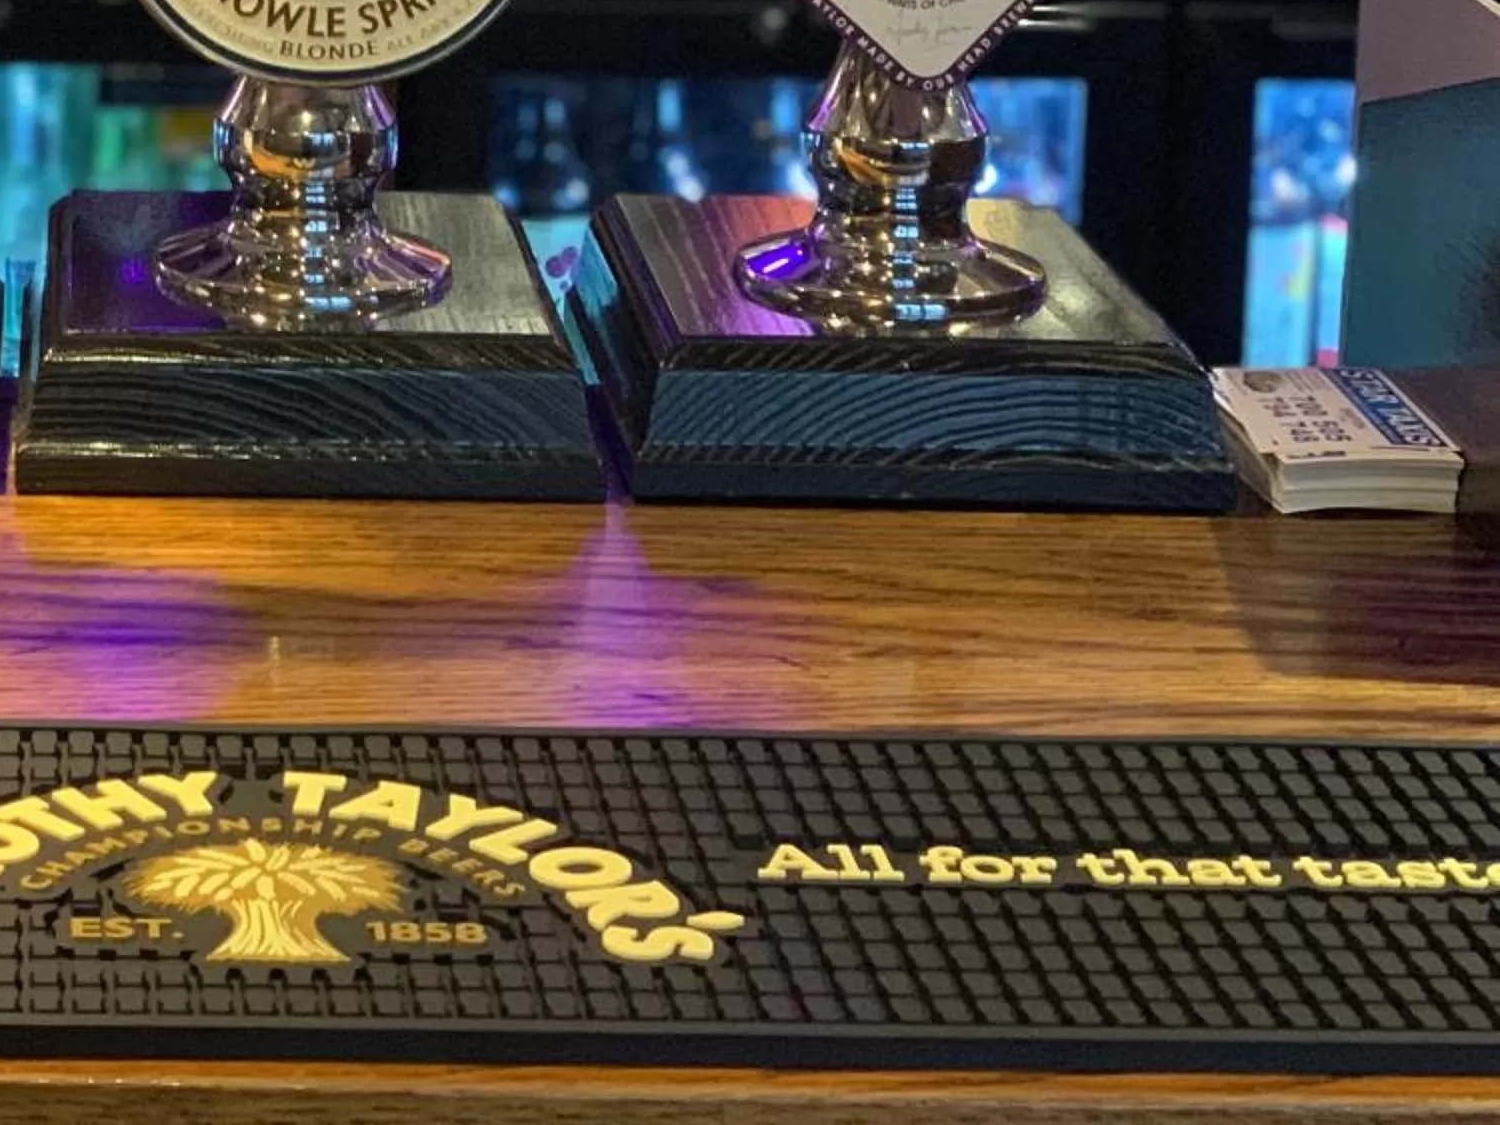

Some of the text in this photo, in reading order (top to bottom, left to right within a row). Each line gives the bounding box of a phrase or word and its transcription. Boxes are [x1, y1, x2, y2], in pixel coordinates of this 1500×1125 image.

[279, 39, 378, 61] BLONDE
[857, 35, 895, 71] MADE
[896, 71, 915, 88] BY
[923, 73, 954, 92] OUR
[957, 37, 992, 72] HEAD
[19, 816, 527, 899] CHAMPIONSHIP BEERS
[283, 771, 744, 960] TAYLOR'S
[757, 843, 904, 882] All
[919, 845, 1057, 884] for
[1076, 848, 1282, 888] that
[70, 916, 489, 946] EST. 1858
